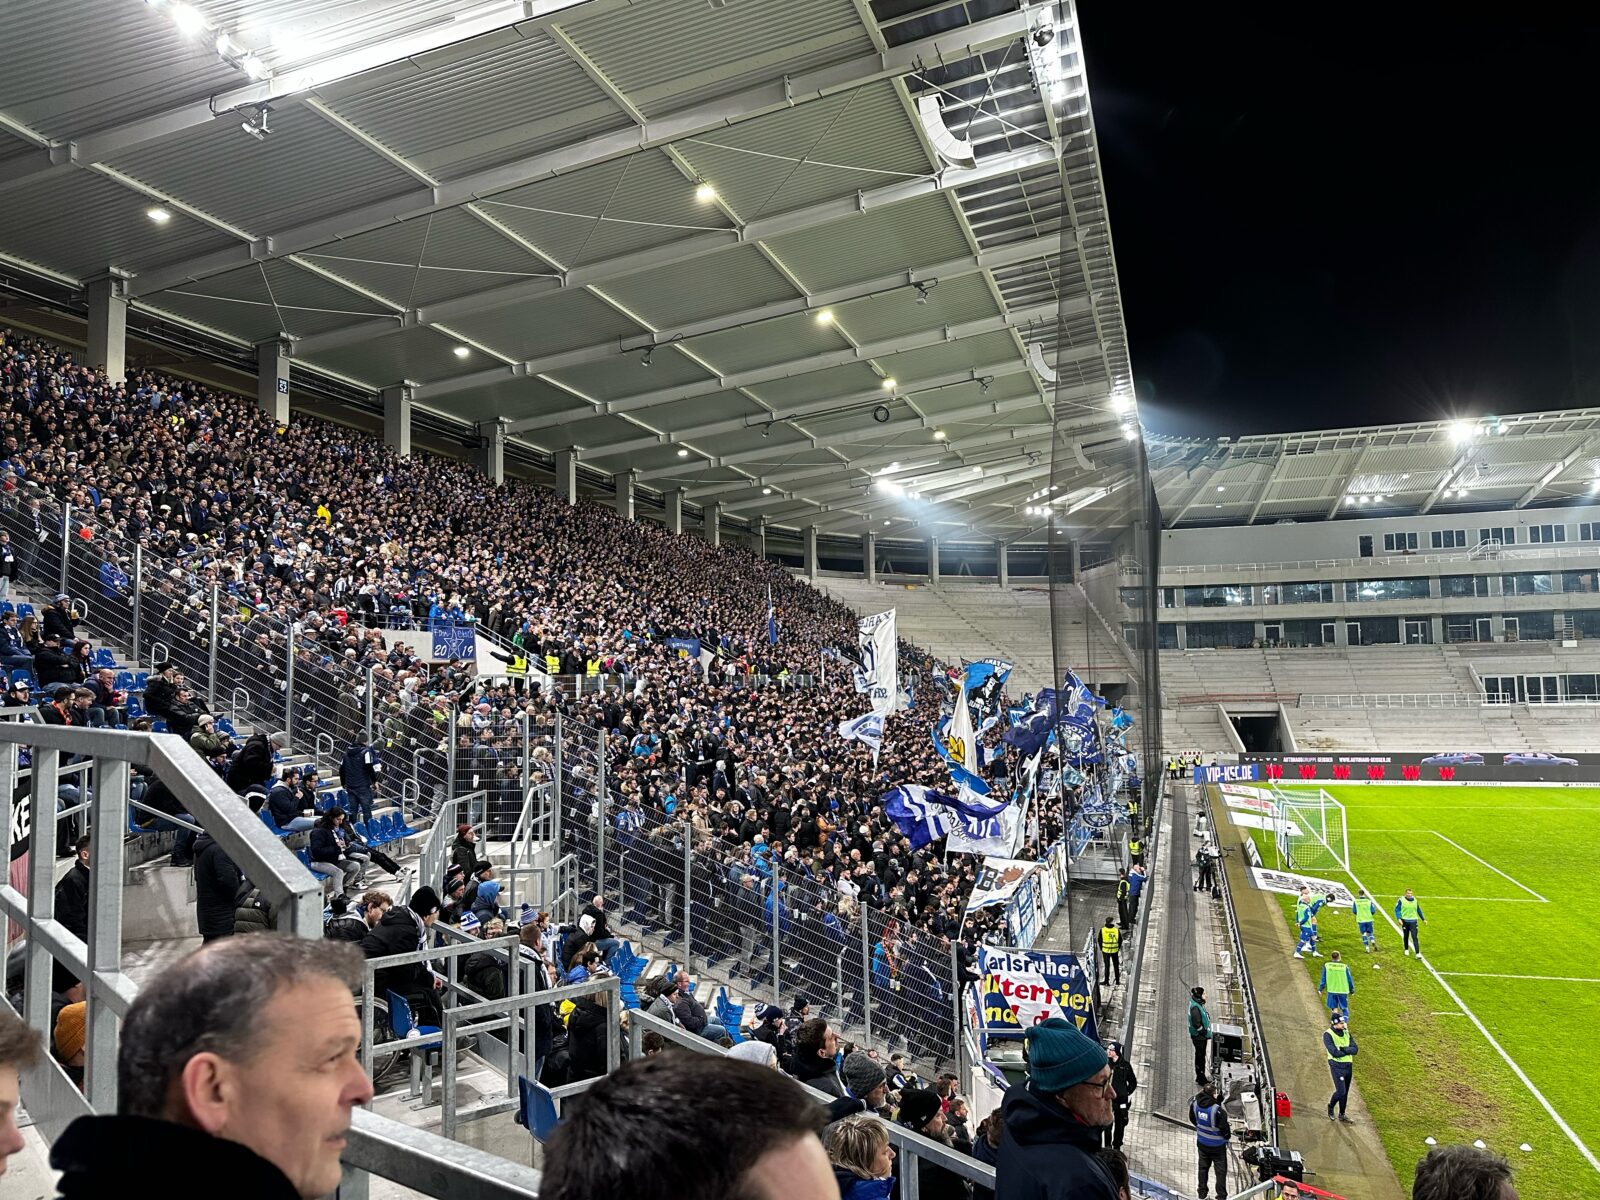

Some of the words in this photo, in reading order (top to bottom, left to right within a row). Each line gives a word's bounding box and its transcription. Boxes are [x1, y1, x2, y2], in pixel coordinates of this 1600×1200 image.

[434, 645, 448, 656] 20
[462, 645, 474, 657] 19
[1206, 765, 1253, 782] VIP-KSC.DE
